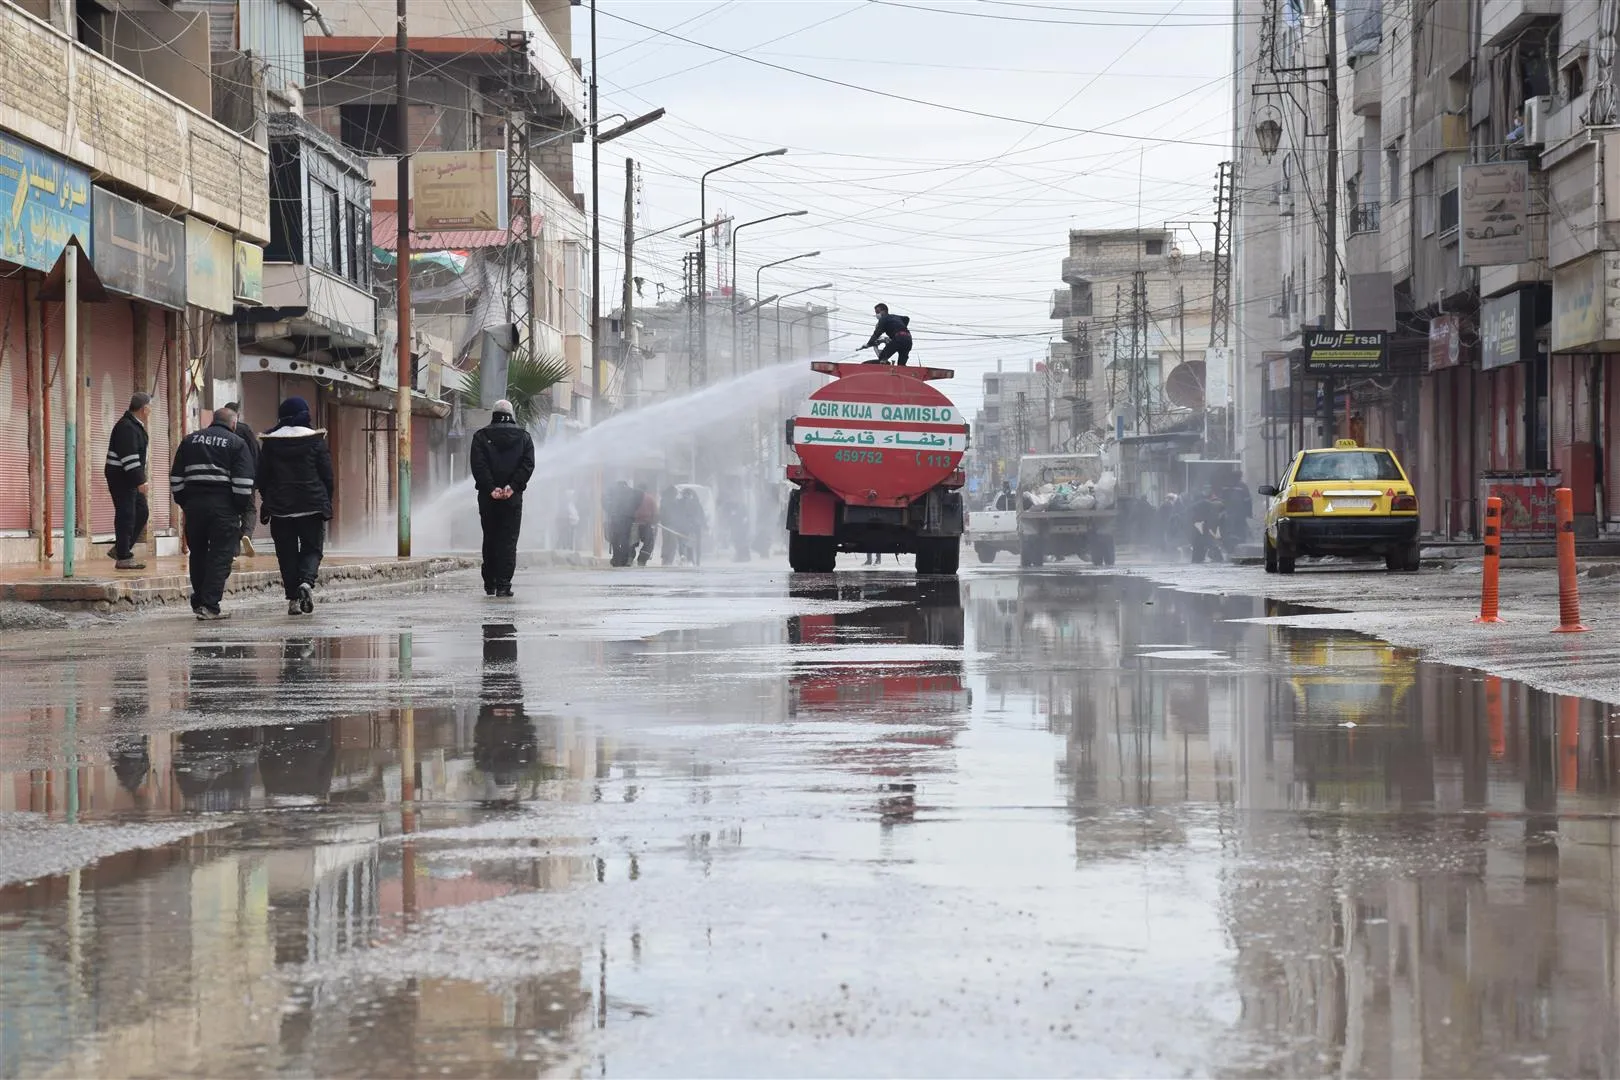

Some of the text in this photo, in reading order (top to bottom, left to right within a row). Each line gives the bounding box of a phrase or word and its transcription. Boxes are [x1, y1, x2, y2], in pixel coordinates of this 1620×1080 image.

[1310, 333, 1343, 348] إرسال
[811, 402, 951, 422] AGIR KUJA QAMISLO
[803, 429, 875, 445] قامشلو
[835, 449, 883, 464] 459752
[927, 455, 951, 468] 113
